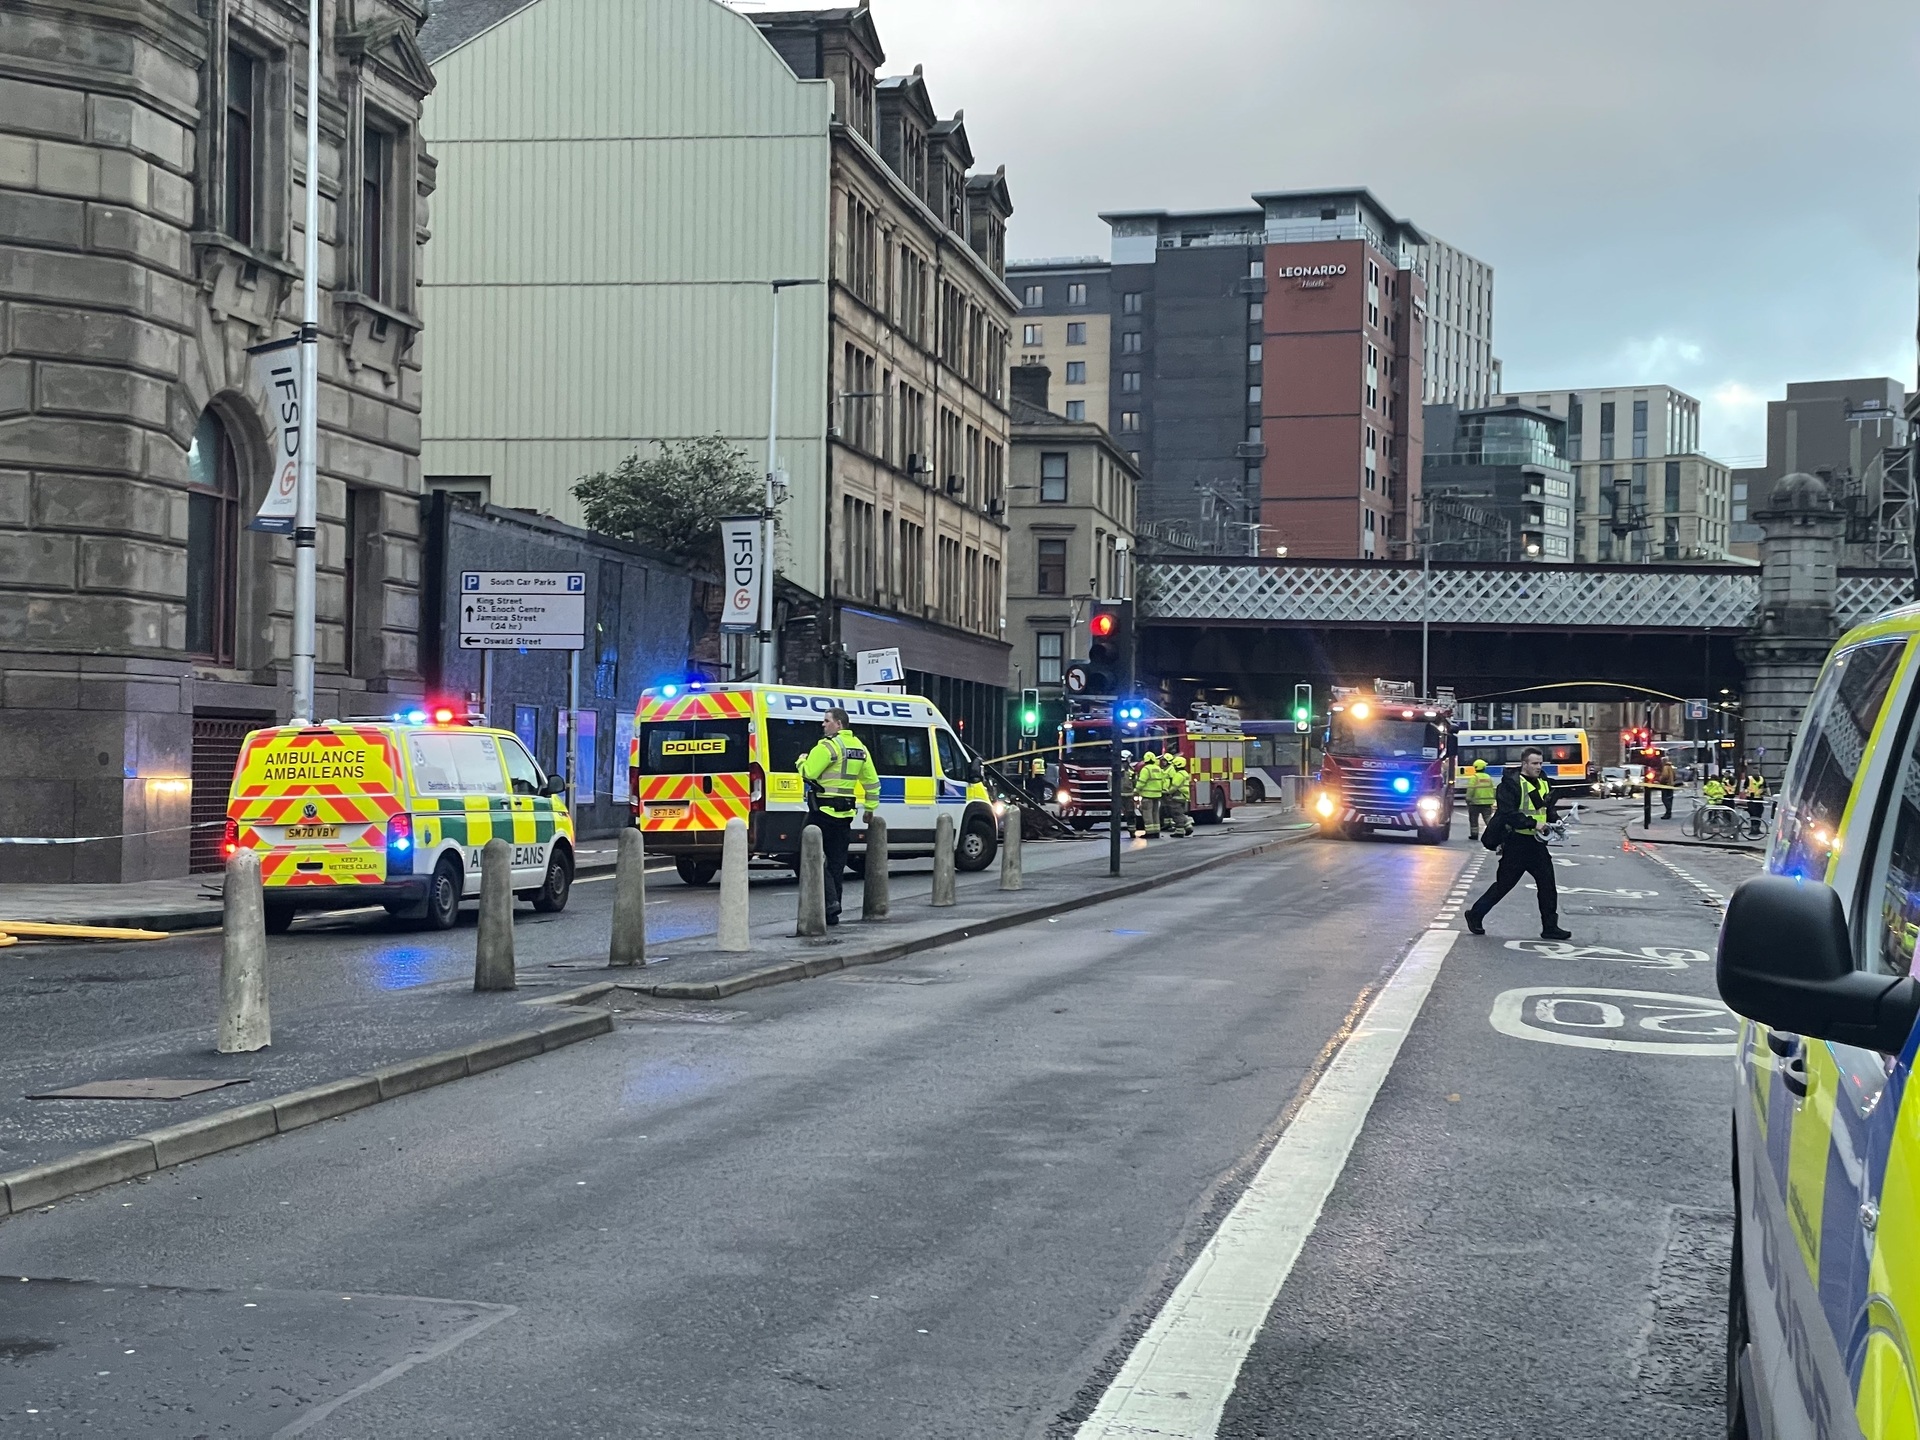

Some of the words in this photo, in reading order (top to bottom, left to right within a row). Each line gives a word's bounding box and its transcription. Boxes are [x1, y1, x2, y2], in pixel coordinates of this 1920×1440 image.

[1279, 264, 1347, 278] LEONARDO
[1301, 279, 1325, 288] Hotels
[270, 367, 300, 457] IFSD
[731, 531, 753, 587] IFSD
[490, 578, 515, 586] South
[516, 578, 531, 586] Car
[476, 597, 495, 605] King
[497, 597, 522, 605] Street
[476, 614, 509, 622] Jamaica
[511, 614, 537, 622] Street
[483, 637, 514, 645] Oswald
[515, 637, 542, 645] Street
[784, 694, 912, 718] POLICE
[1470, 734, 1568, 742] POLICE
[665, 742, 722, 752] POLICE
[264, 750, 366, 766] AMBULANCE
[1361, 760, 1400, 769] SCANIA
[263, 766, 365, 780] AMBAILEANS
[288, 828, 314, 838] SM70
[316, 827, 336, 837] VBY
